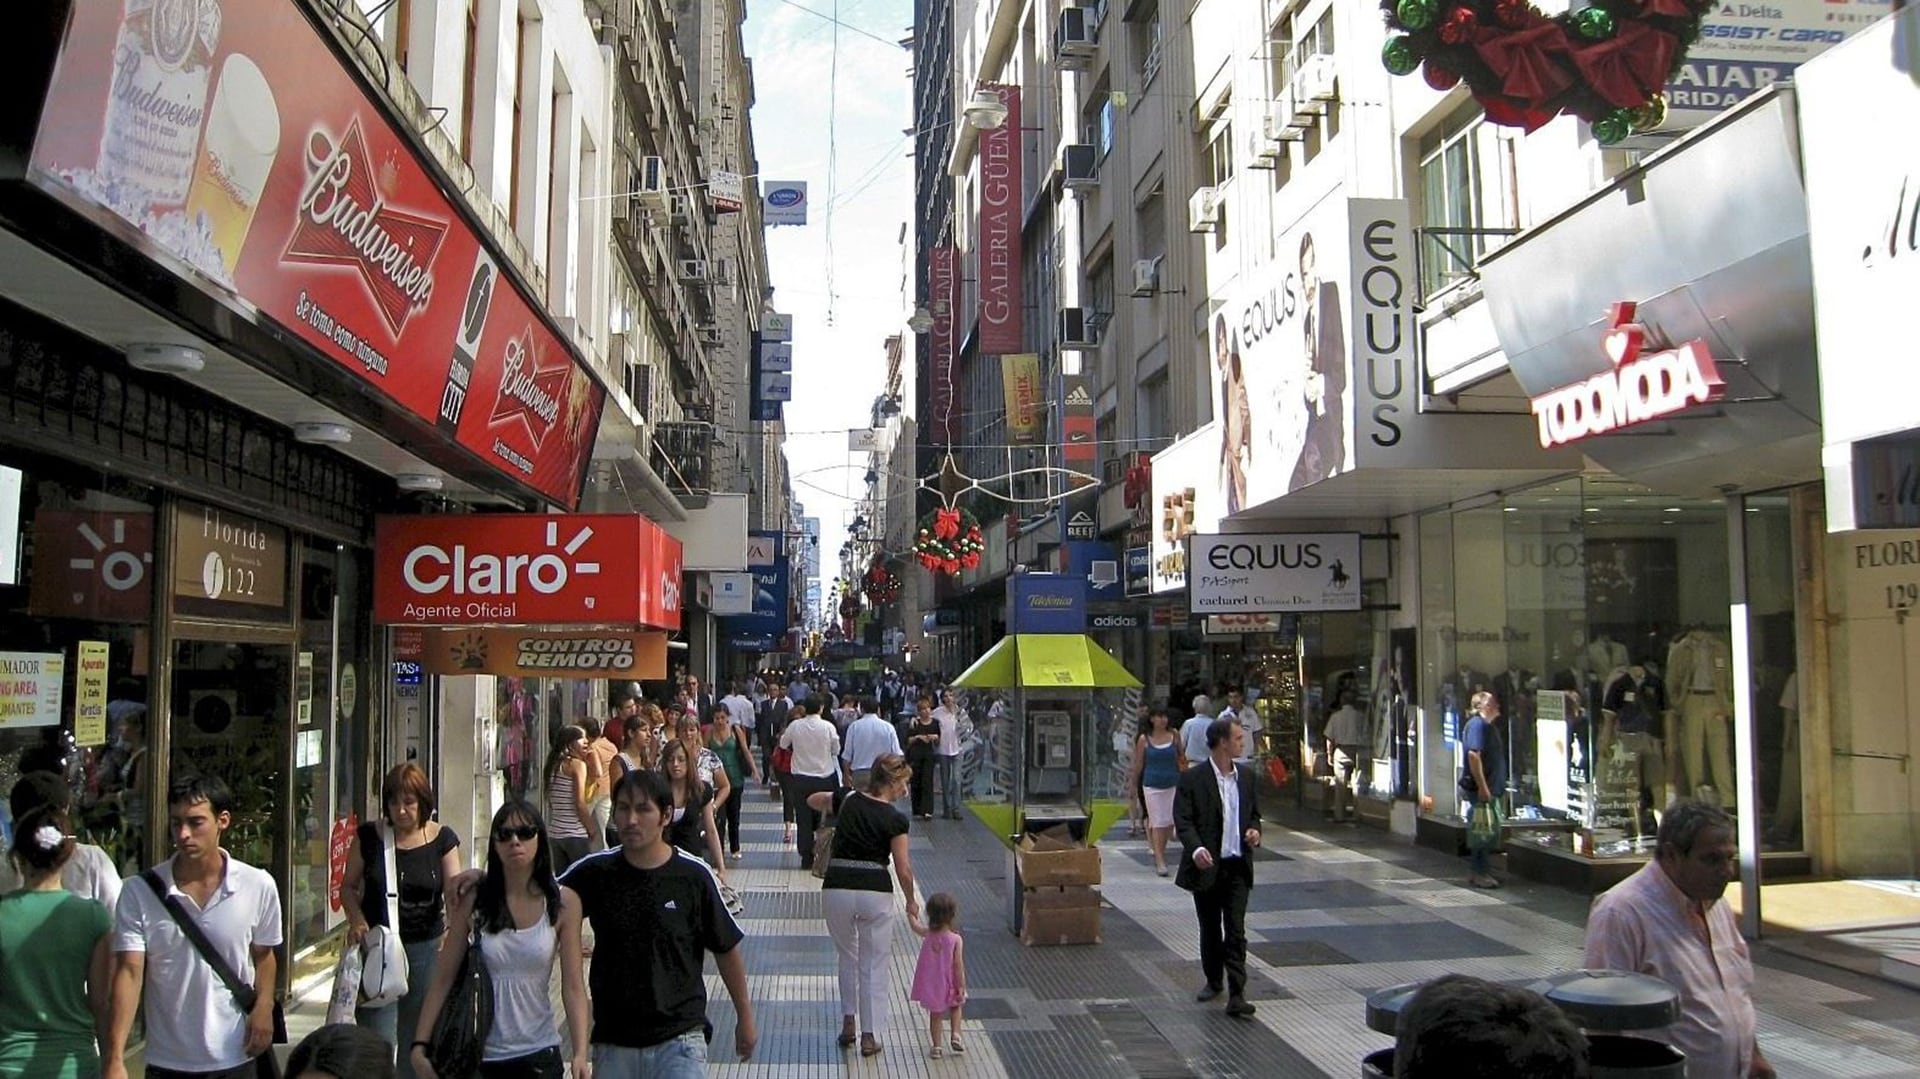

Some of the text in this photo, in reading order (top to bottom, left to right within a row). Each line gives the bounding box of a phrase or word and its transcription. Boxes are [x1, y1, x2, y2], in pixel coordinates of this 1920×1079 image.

[1740, 4, 1783, 19] Delta
[114, 45, 202, 128] Budweiser
[303, 129, 433, 311] Budweiser
[1242, 272, 1296, 349] EQUUS
[296, 291, 388, 376] Se toma como ninguna
[1362, 220, 1402, 447] EQUUS
[501, 340, 560, 425] Budweiser
[1532, 345, 1712, 448] TODOMODA
[442, 380, 466, 424] CITY
[203, 507, 266, 550] Florida
[1067, 527, 1095, 539] REEF
[403, 544, 568, 594] Claro
[1208, 543, 1322, 571] EQUUS
[227, 566, 254, 596] 122
[403, 602, 516, 620] Agente Oficial
[1199, 595, 1248, 606] cacharel
[1094, 615, 1138, 627] adidas
[516, 653, 634, 669] REMOTO
[517, 637, 634, 653] CONTROL
[14, 680, 38, 696] AREA
